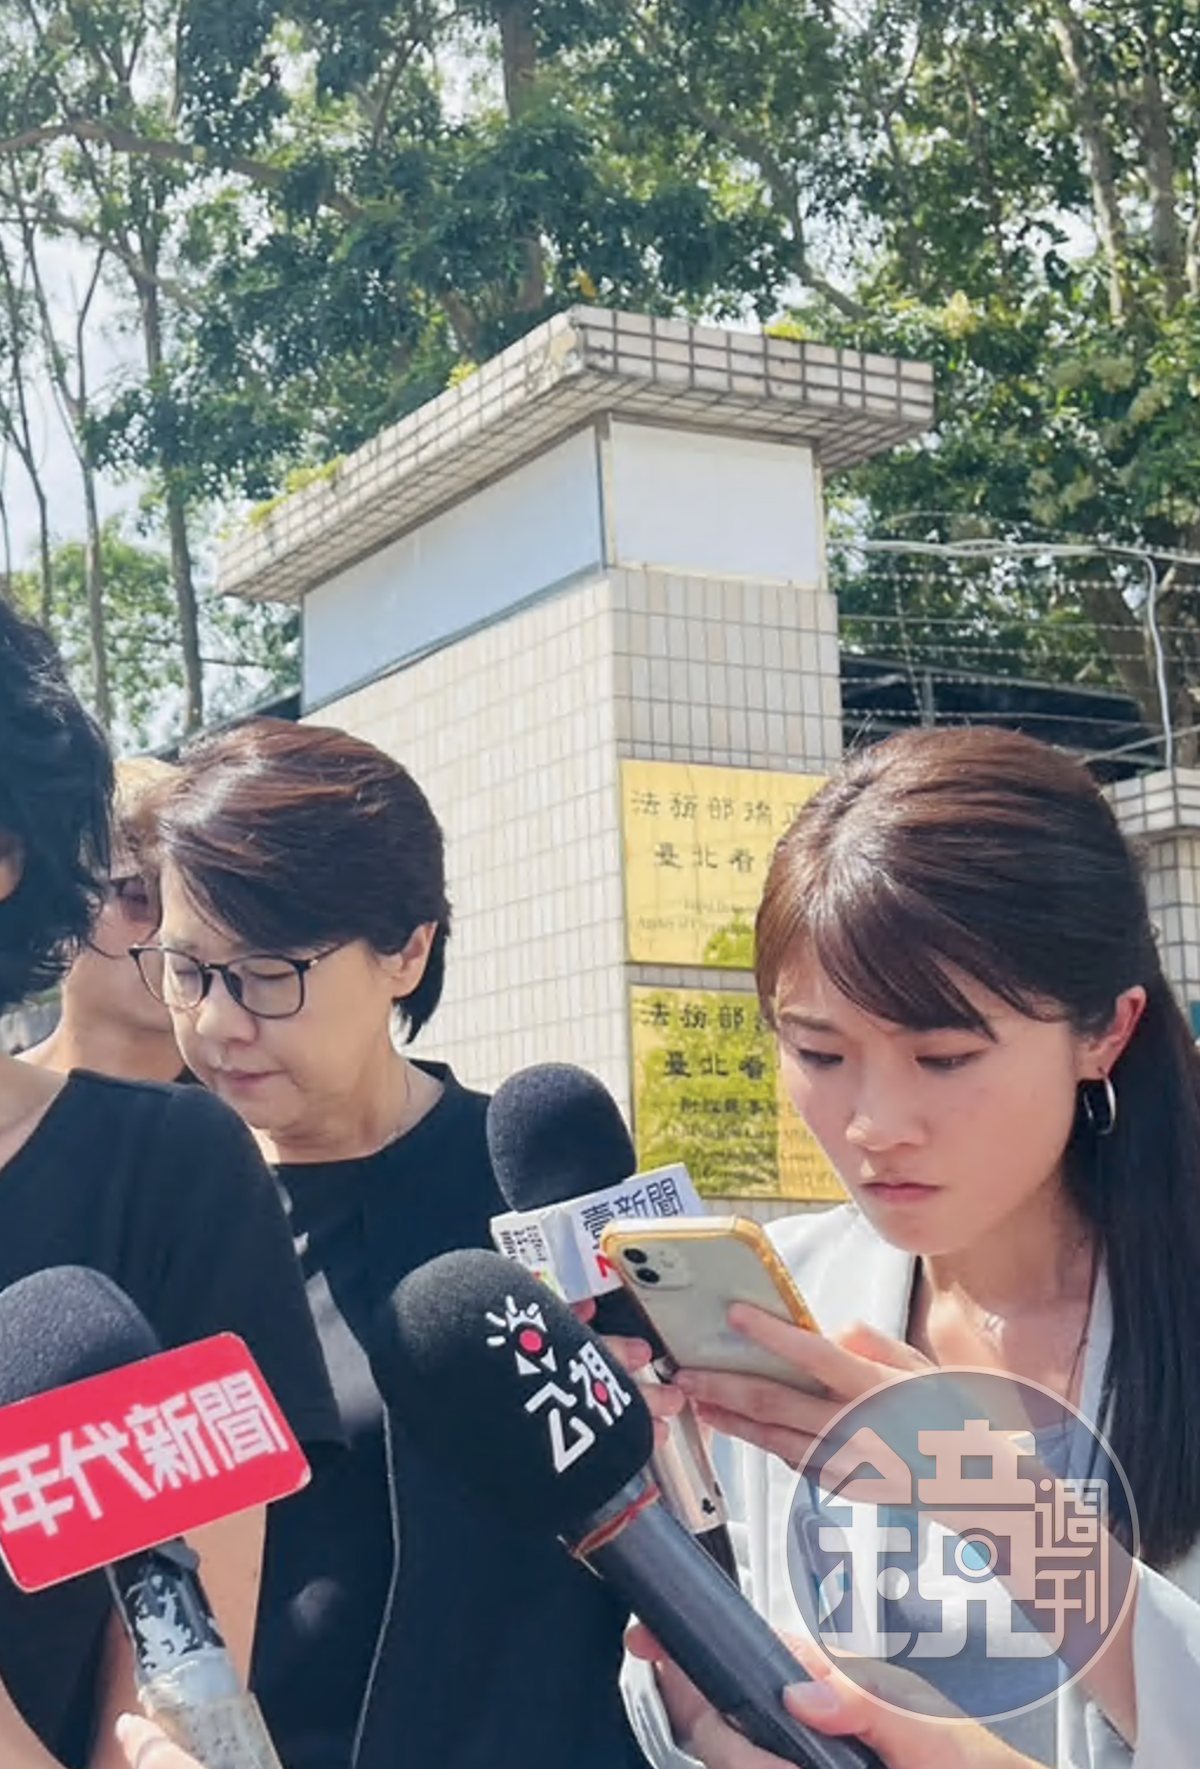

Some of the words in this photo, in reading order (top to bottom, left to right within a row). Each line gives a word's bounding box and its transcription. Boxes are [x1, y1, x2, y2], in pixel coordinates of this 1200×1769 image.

[654, 841, 773, 874] 臺北看
[636, 999, 766, 1031] 法務部
[524, 1340, 631, 1474] 公視
